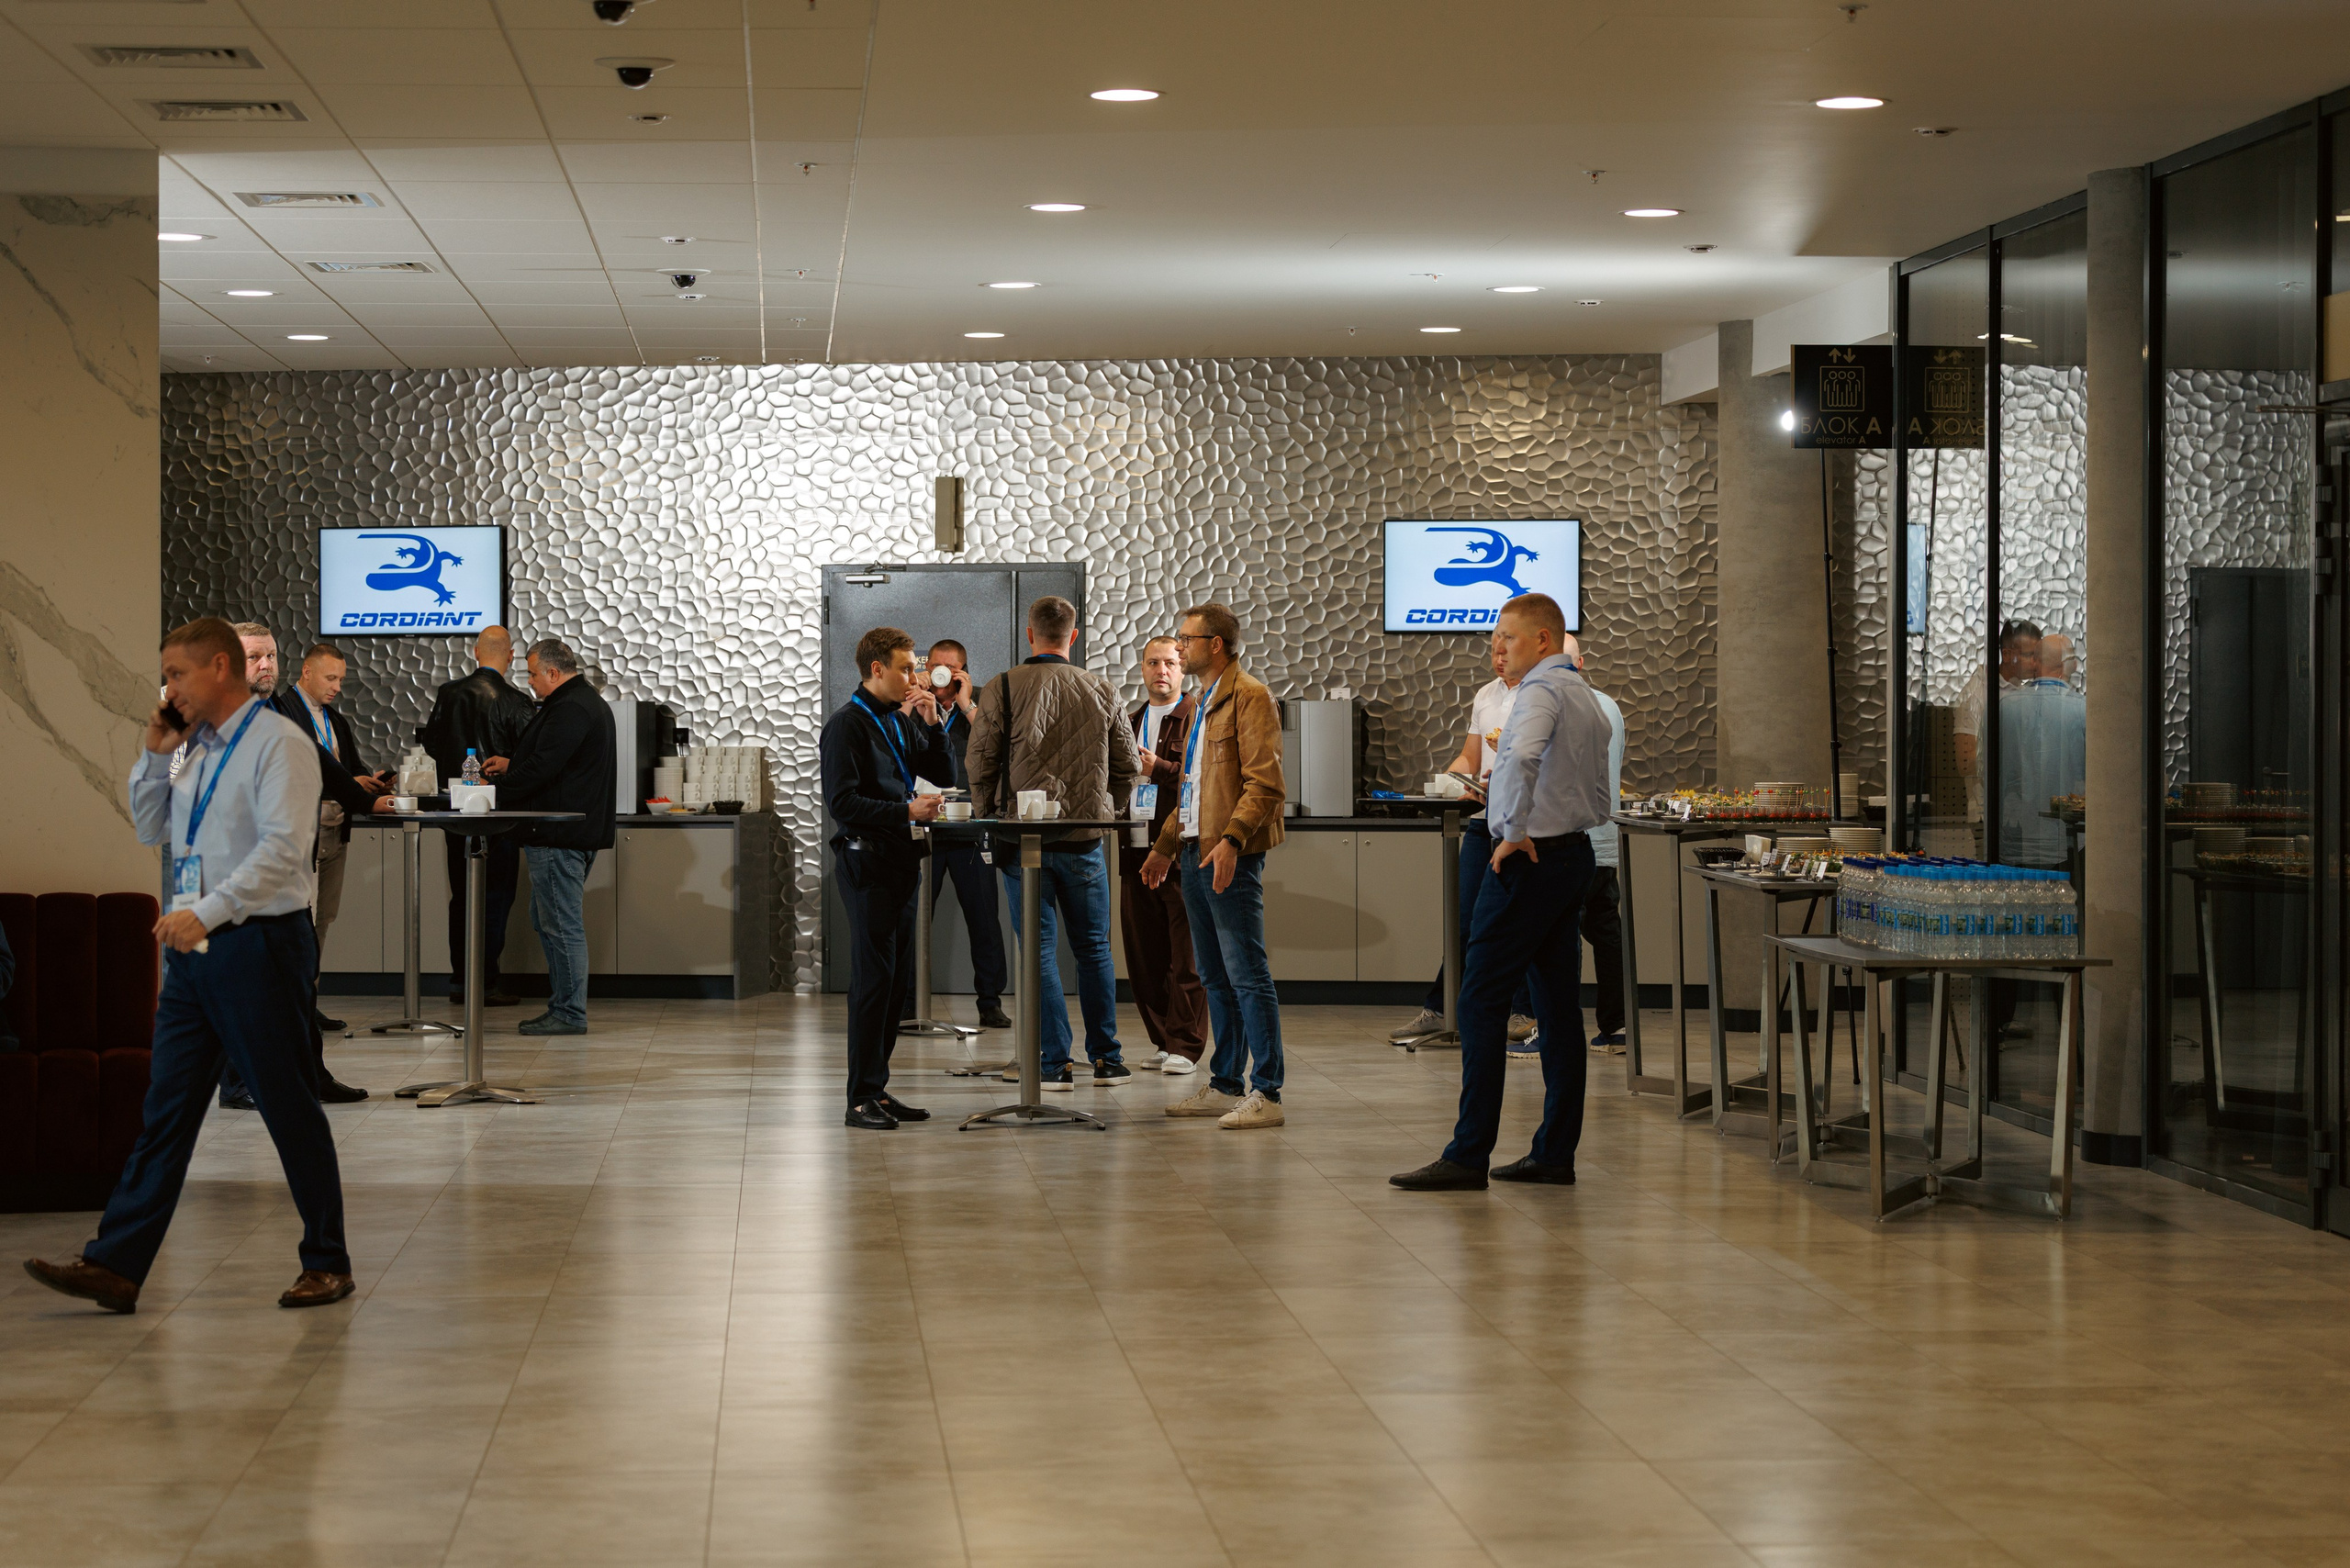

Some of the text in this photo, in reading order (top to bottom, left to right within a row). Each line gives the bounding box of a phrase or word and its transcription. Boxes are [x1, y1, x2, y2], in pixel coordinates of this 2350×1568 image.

[1801, 417, 1859, 435] БЛОК
[1816, 435, 1866, 444] elevator A
[340, 611, 483, 627] CORDIANT
[1405, 609, 1501, 624] CORDI
